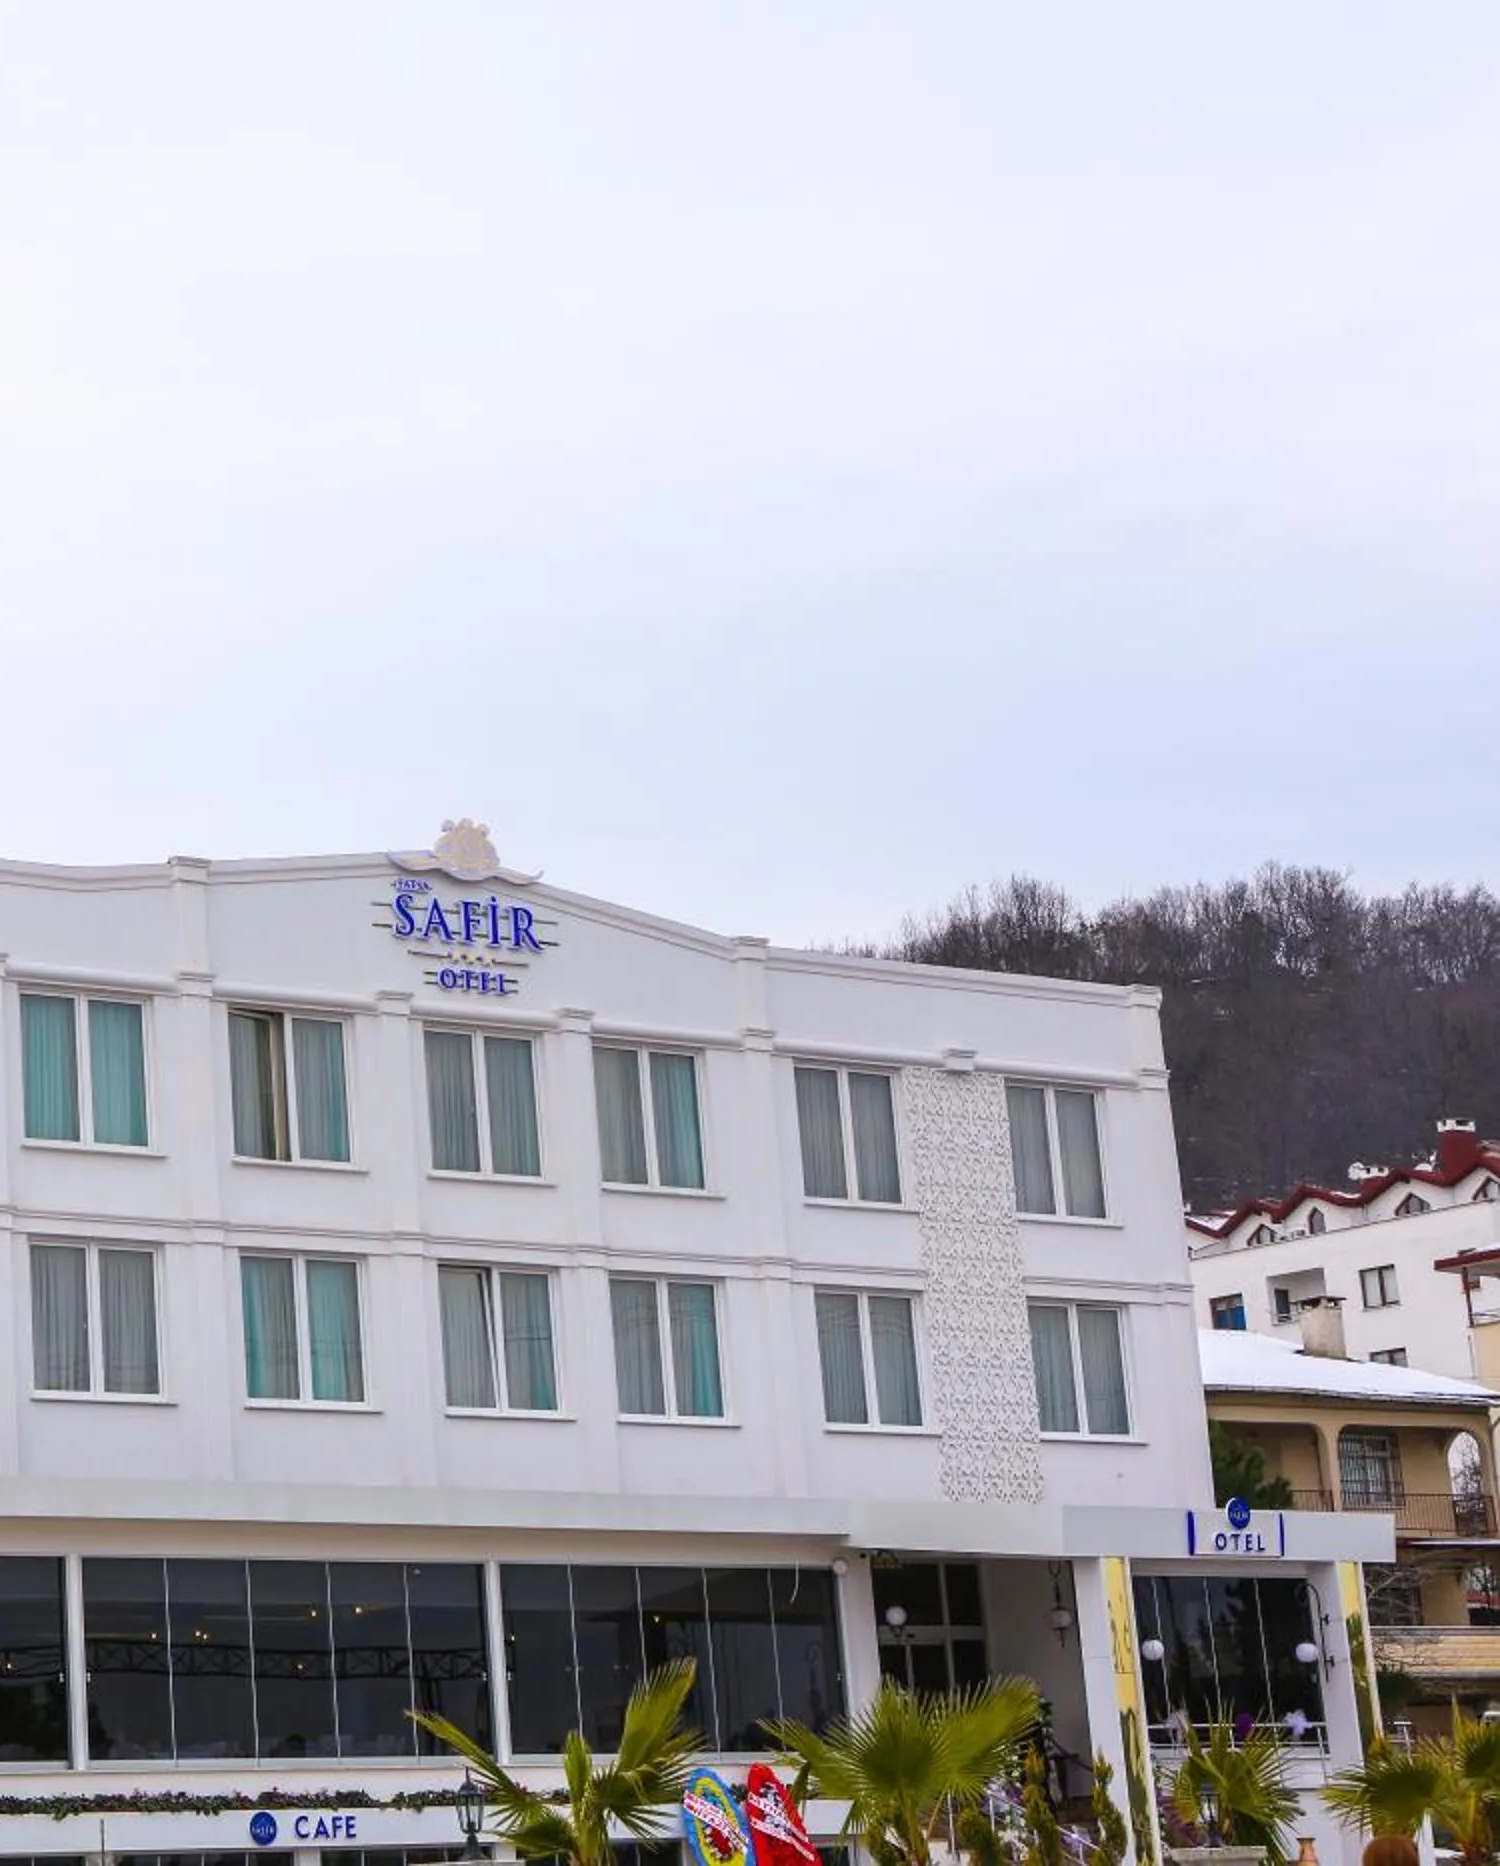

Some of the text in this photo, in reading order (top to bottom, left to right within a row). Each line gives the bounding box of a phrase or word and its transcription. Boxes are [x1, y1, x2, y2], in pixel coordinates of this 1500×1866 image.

[394, 893, 543, 950] SAFİR
[439, 968, 506, 994] OTEL
[1214, 1533, 1266, 1552] OTEL
[295, 1815, 357, 1839] CAFE
